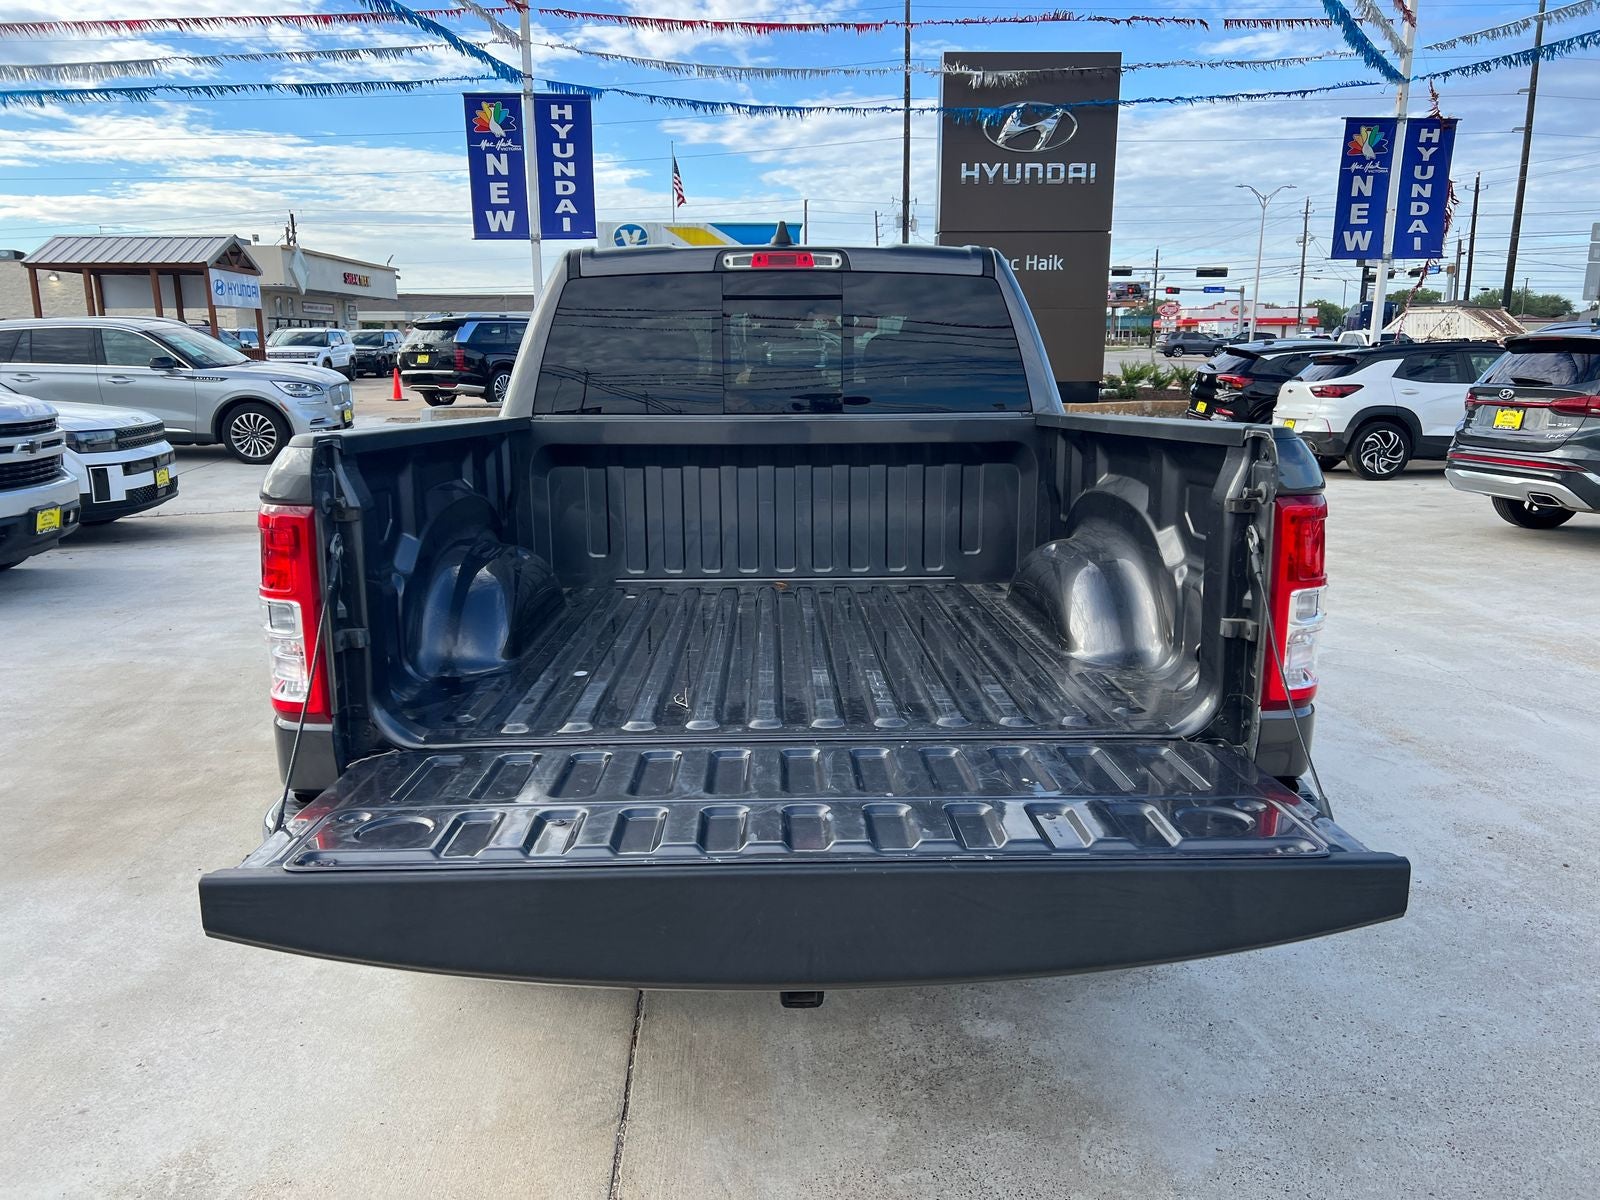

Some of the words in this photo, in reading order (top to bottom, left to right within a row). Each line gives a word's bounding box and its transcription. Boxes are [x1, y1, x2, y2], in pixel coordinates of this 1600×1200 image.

[475, 138, 495, 151] Mac
[495, 138, 517, 151] Haik
[550, 104, 579, 232] HYUNDAI
[961, 162, 1096, 185] HYUNDAI
[1346, 161, 1364, 173] Mac
[485, 153, 516, 232] NEW
[1407, 128, 1441, 251] HYUNDAI
[1343, 175, 1374, 252] NEW
[1025, 254, 1064, 271] Haik
[227, 281, 259, 299] HYUNDAI
